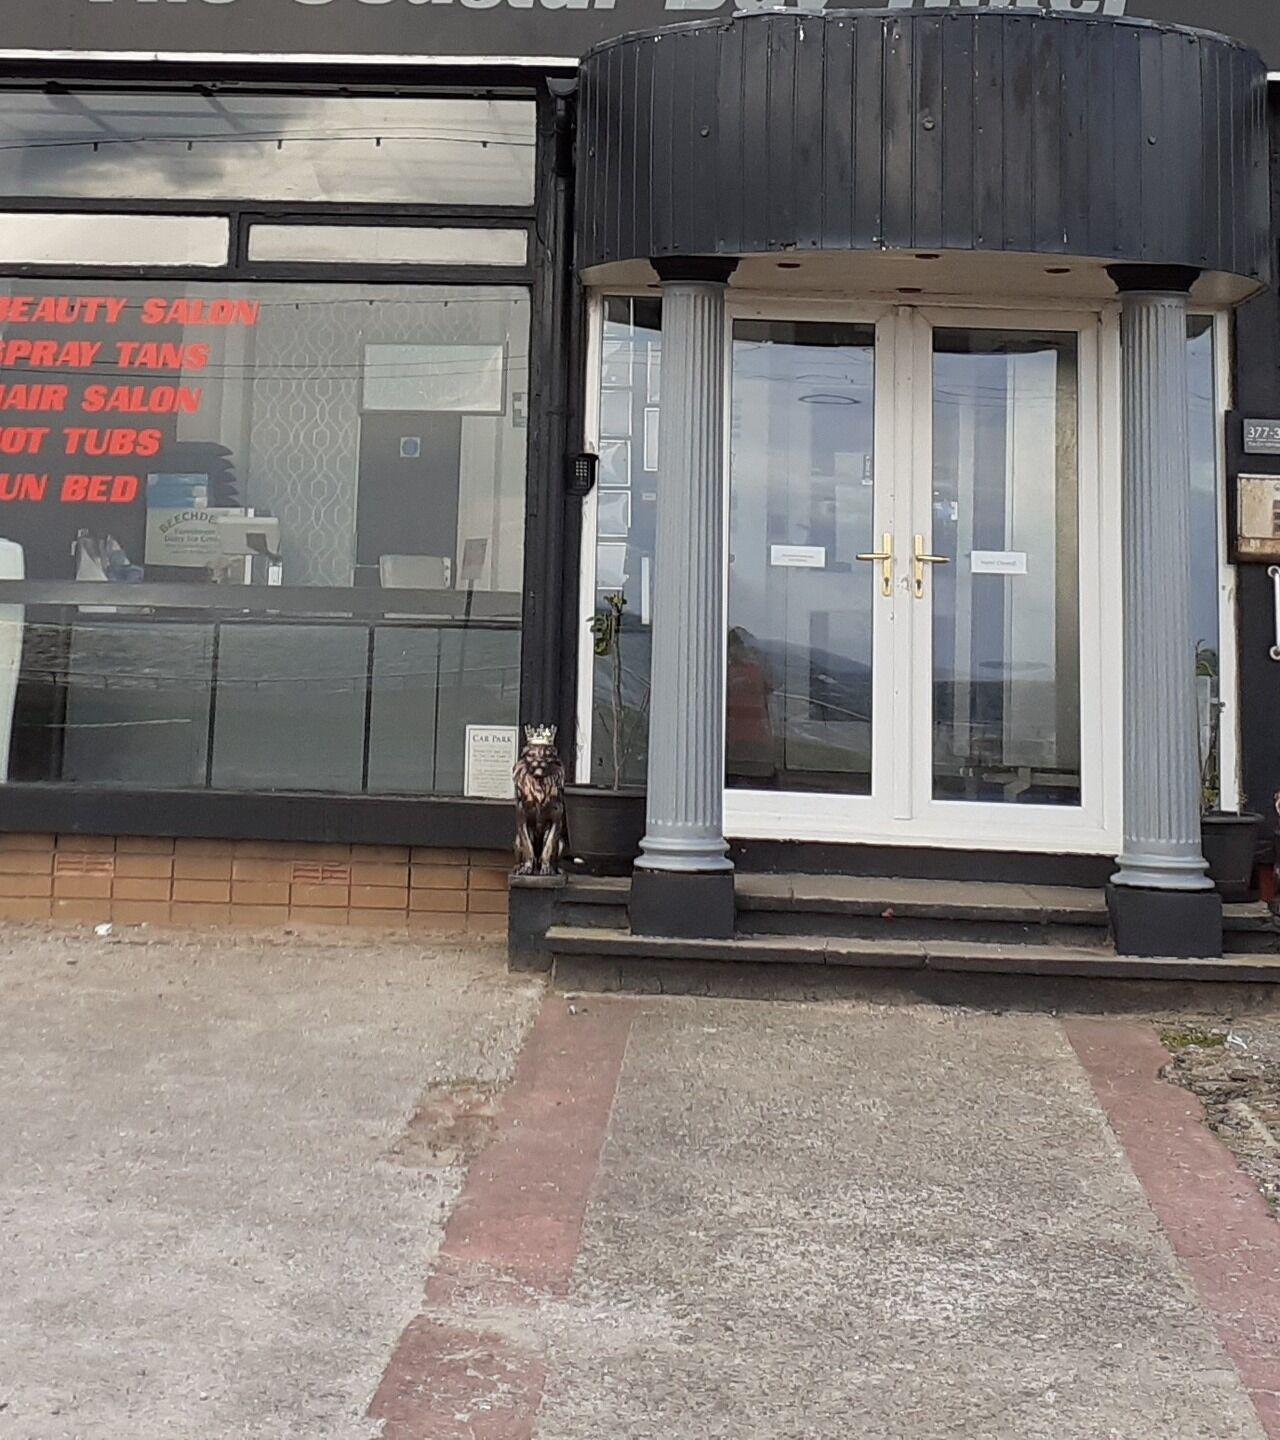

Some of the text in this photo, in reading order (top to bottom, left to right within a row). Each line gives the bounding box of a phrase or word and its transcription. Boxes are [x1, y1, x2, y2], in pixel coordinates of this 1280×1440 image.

[140, 298, 260, 326] SALON
[116, 341, 211, 370] TANS
[82, 385, 203, 413] SALON
[63, 428, 162, 457] TUBS
[60, 475, 139, 503] BED
